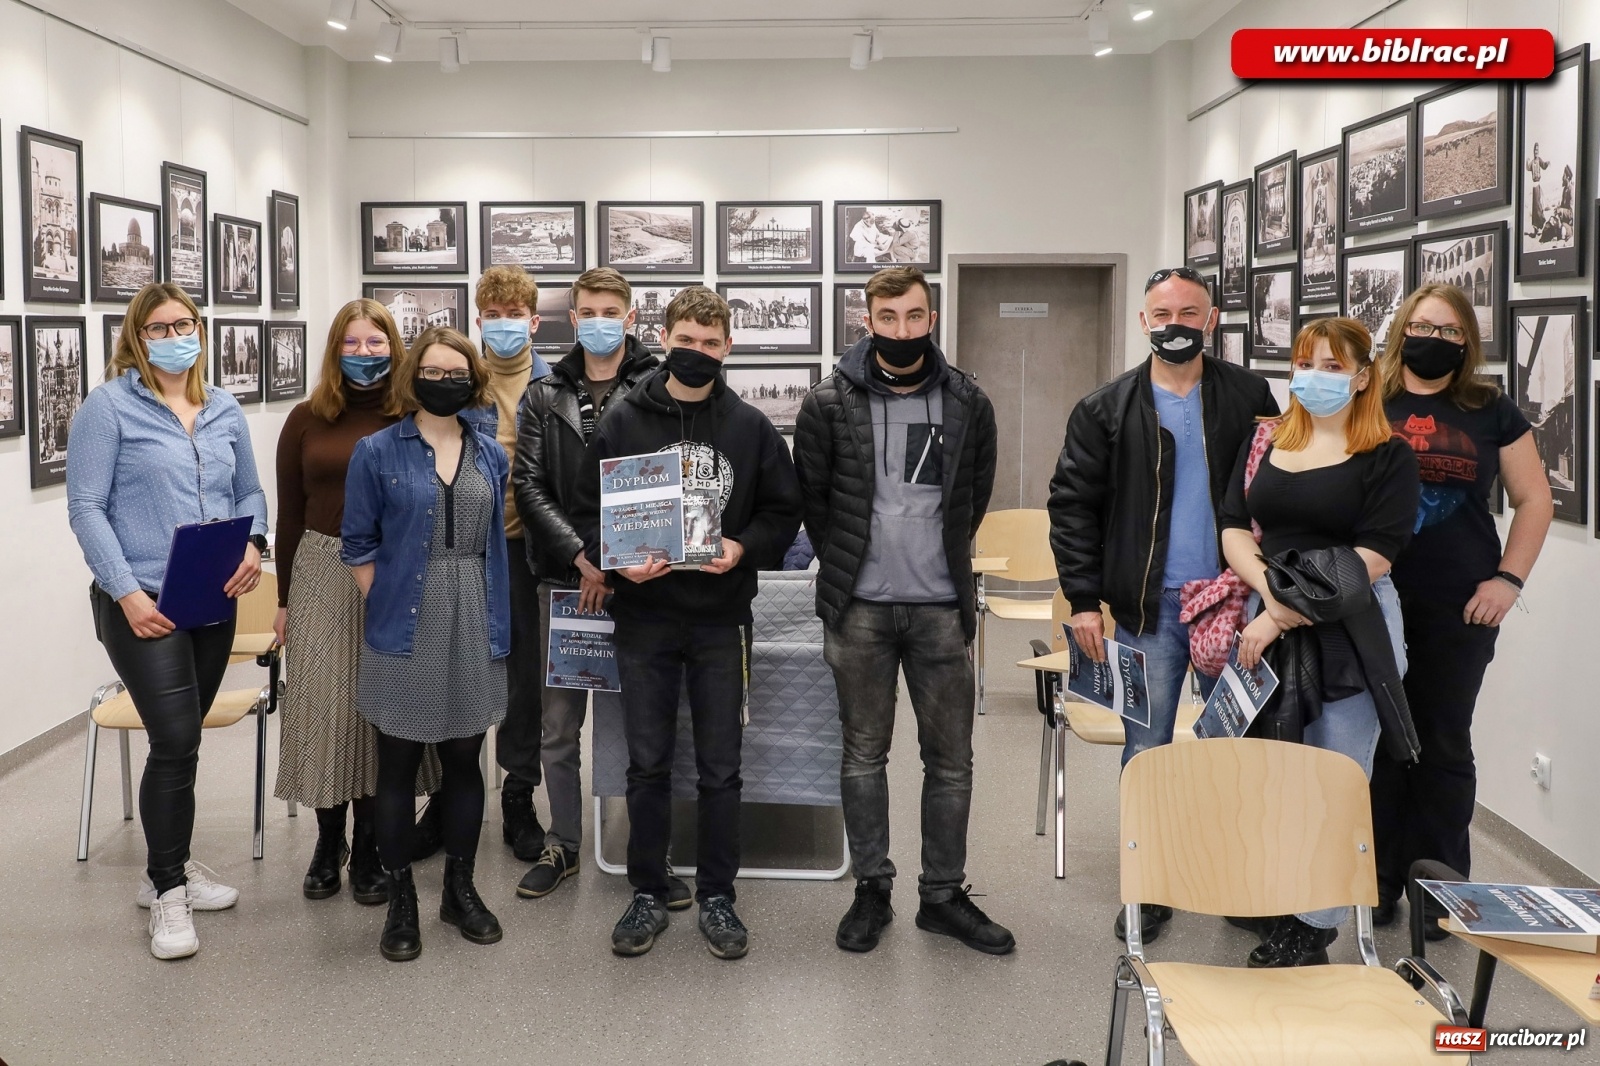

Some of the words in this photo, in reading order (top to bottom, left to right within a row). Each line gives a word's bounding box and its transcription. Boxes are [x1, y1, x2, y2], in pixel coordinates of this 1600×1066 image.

[612, 473, 670, 490] DYPLOM
[612, 518, 673, 533] WIEDŹMIN
[559, 646, 615, 658] WIEDŹMIN
[1093, 659, 1102, 695] DŹMIN
[1121, 654, 1134, 709] DYPLOM
[1233, 661, 1262, 701] DYPLOM
[1487, 888, 1543, 928] WIEDŹMIN
